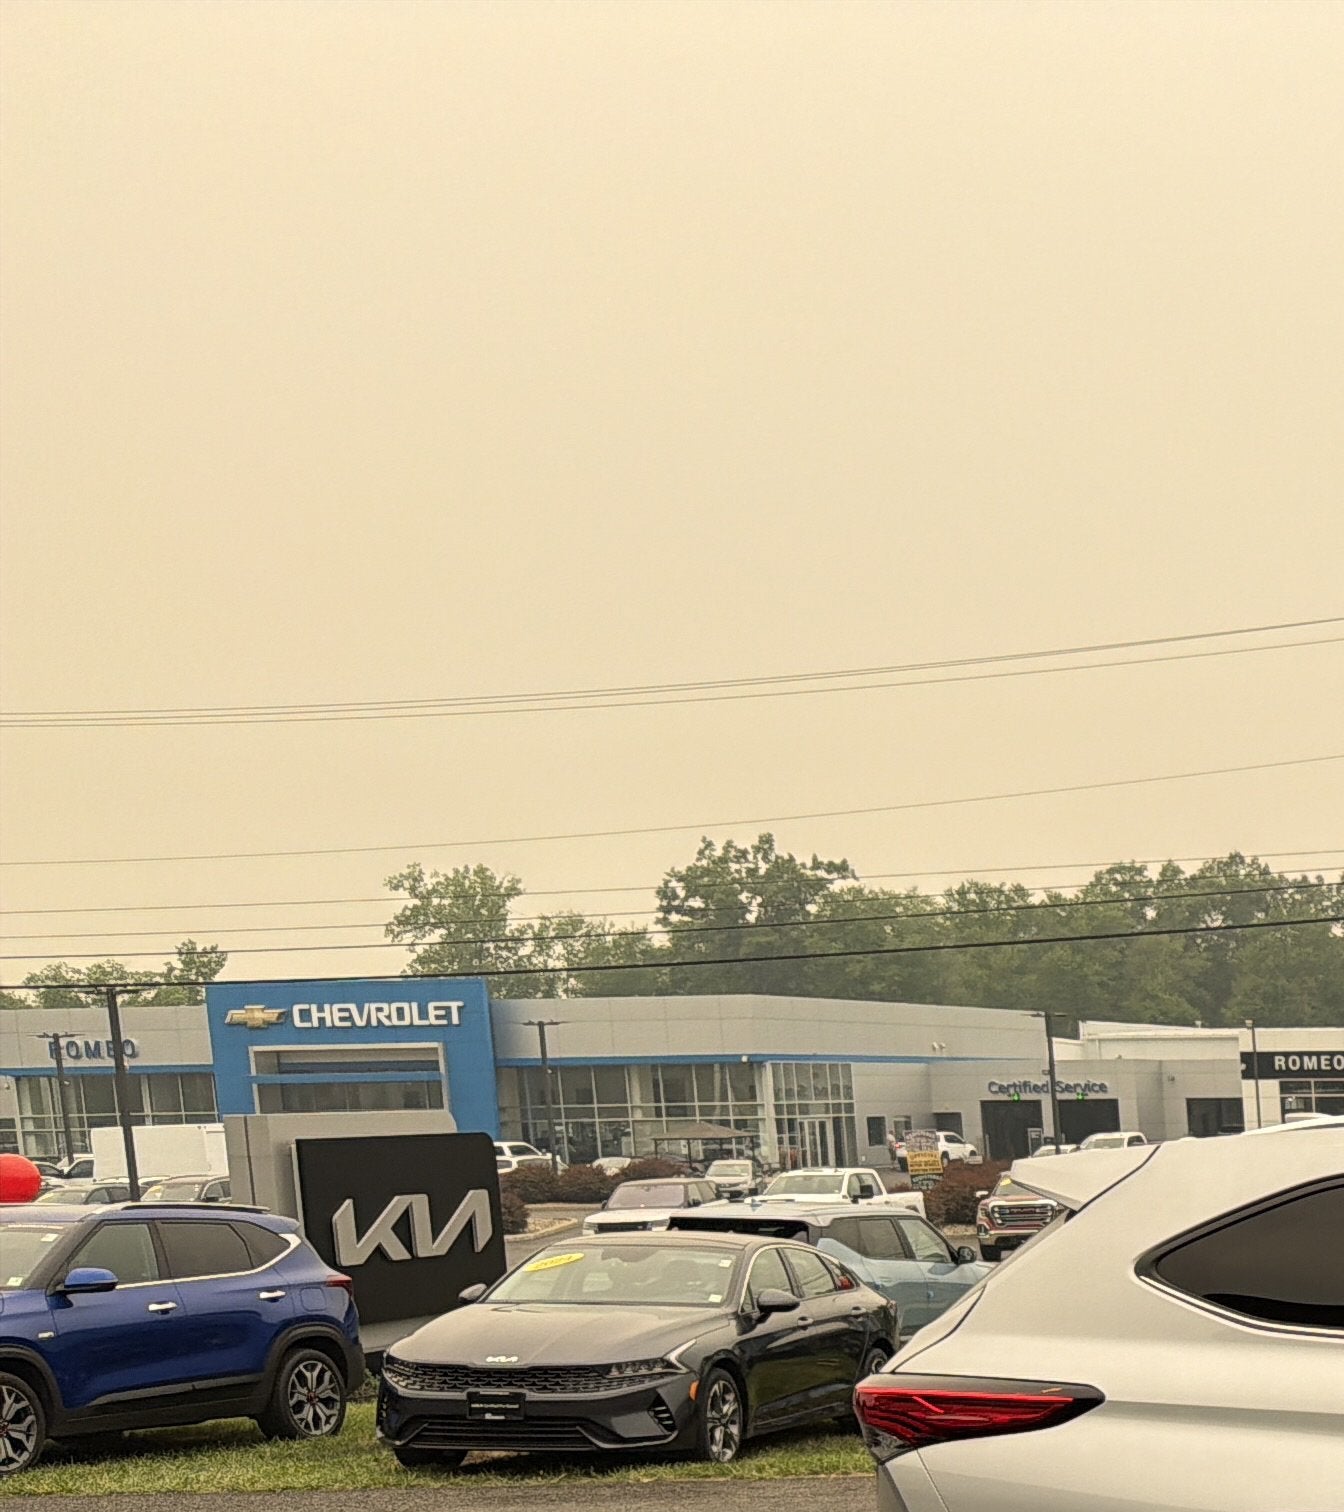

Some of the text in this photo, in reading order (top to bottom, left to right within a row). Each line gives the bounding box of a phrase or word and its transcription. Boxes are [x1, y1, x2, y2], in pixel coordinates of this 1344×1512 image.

[293, 1001, 464, 1028] CHEVROLET
[988, 1080, 1108, 1094] Certified Service
[332, 1189, 493, 1267] KIA
